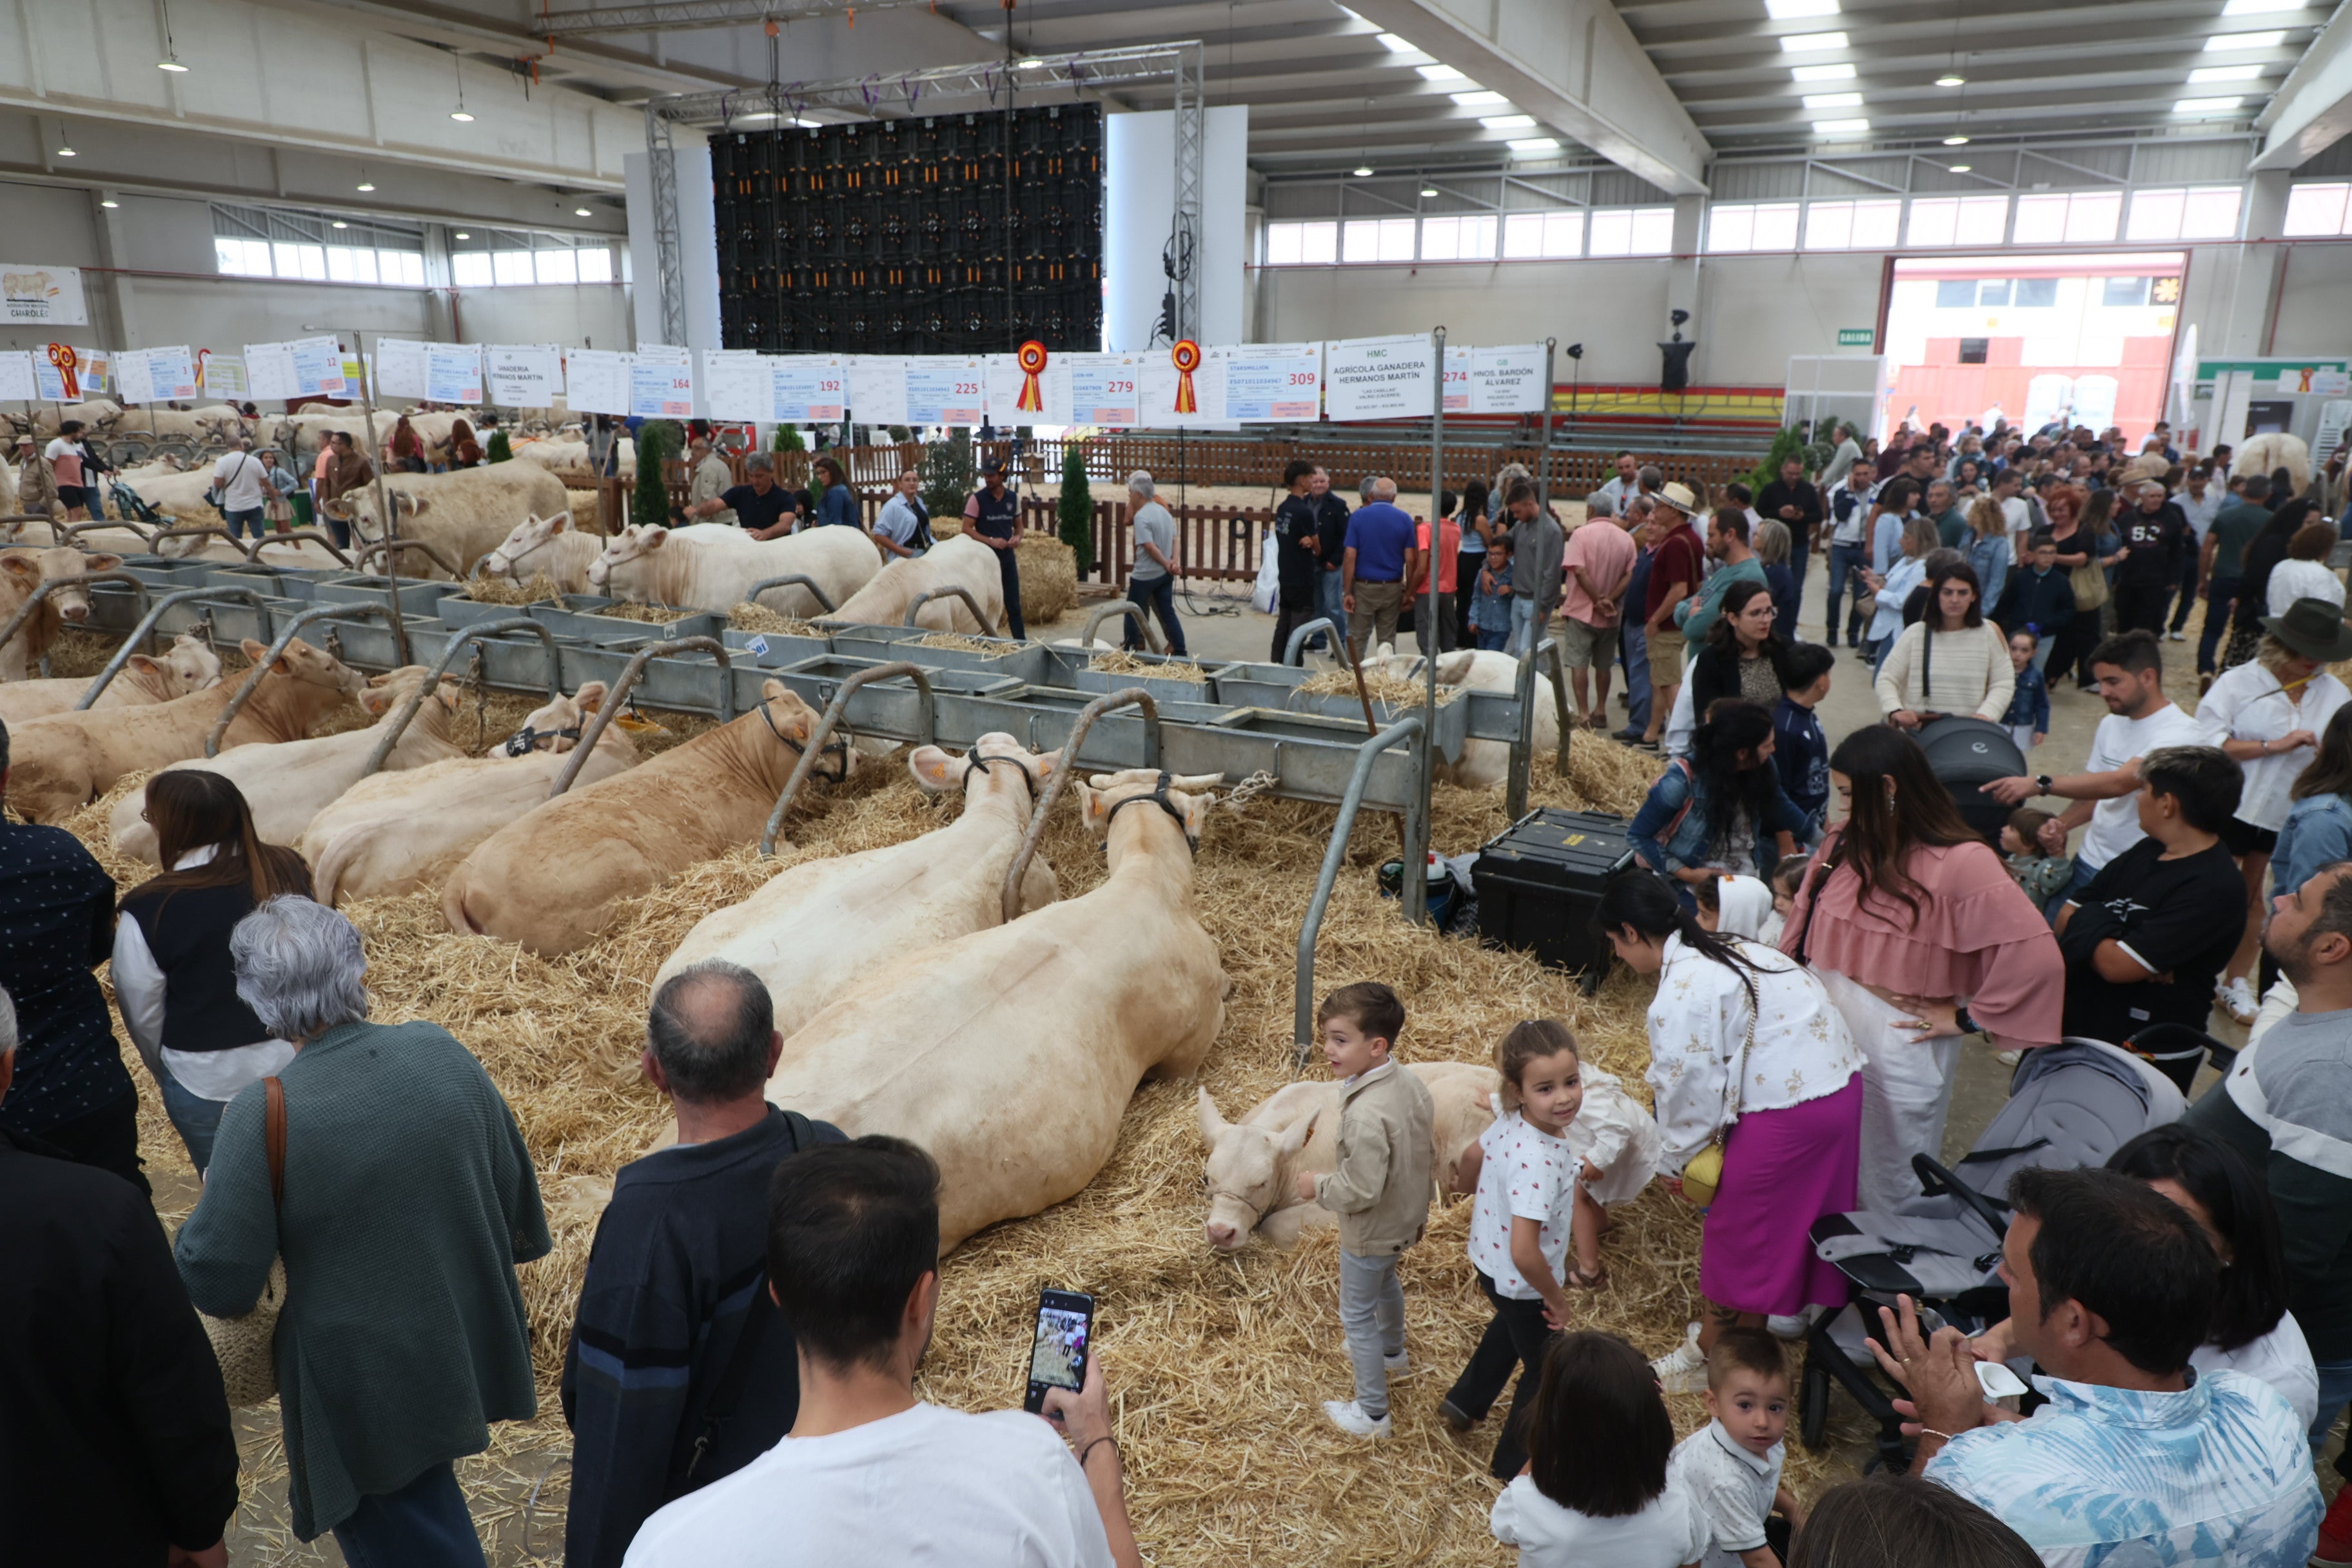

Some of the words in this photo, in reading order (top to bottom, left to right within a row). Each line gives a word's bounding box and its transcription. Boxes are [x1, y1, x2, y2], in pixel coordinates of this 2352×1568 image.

[11, 308, 49, 317] CHAROLÉS
[1840, 333, 1871, 342] SALIDA
[1367, 349, 1387, 358] HMC
[327, 357, 337, 367] 12
[182, 366, 187, 375] 3
[1334, 364, 1375, 375] AGRÍCOLA
[1377, 361, 1426, 372] GANADERA
[1499, 368, 1533, 376] BARDÓN
[1289, 373, 1315, 386] 309
[1339, 374, 1386, 384] HERMANOS
[1387, 372, 1420, 380] MARTÍN
[1443, 371, 1467, 382] 274
[1485, 377, 1521, 386] ÁLVAREZ
[672, 379, 690, 389] 164
[820, 380, 840, 391] 192
[956, 383, 978, 394] 225
[1108, 381, 1133, 393] 279
